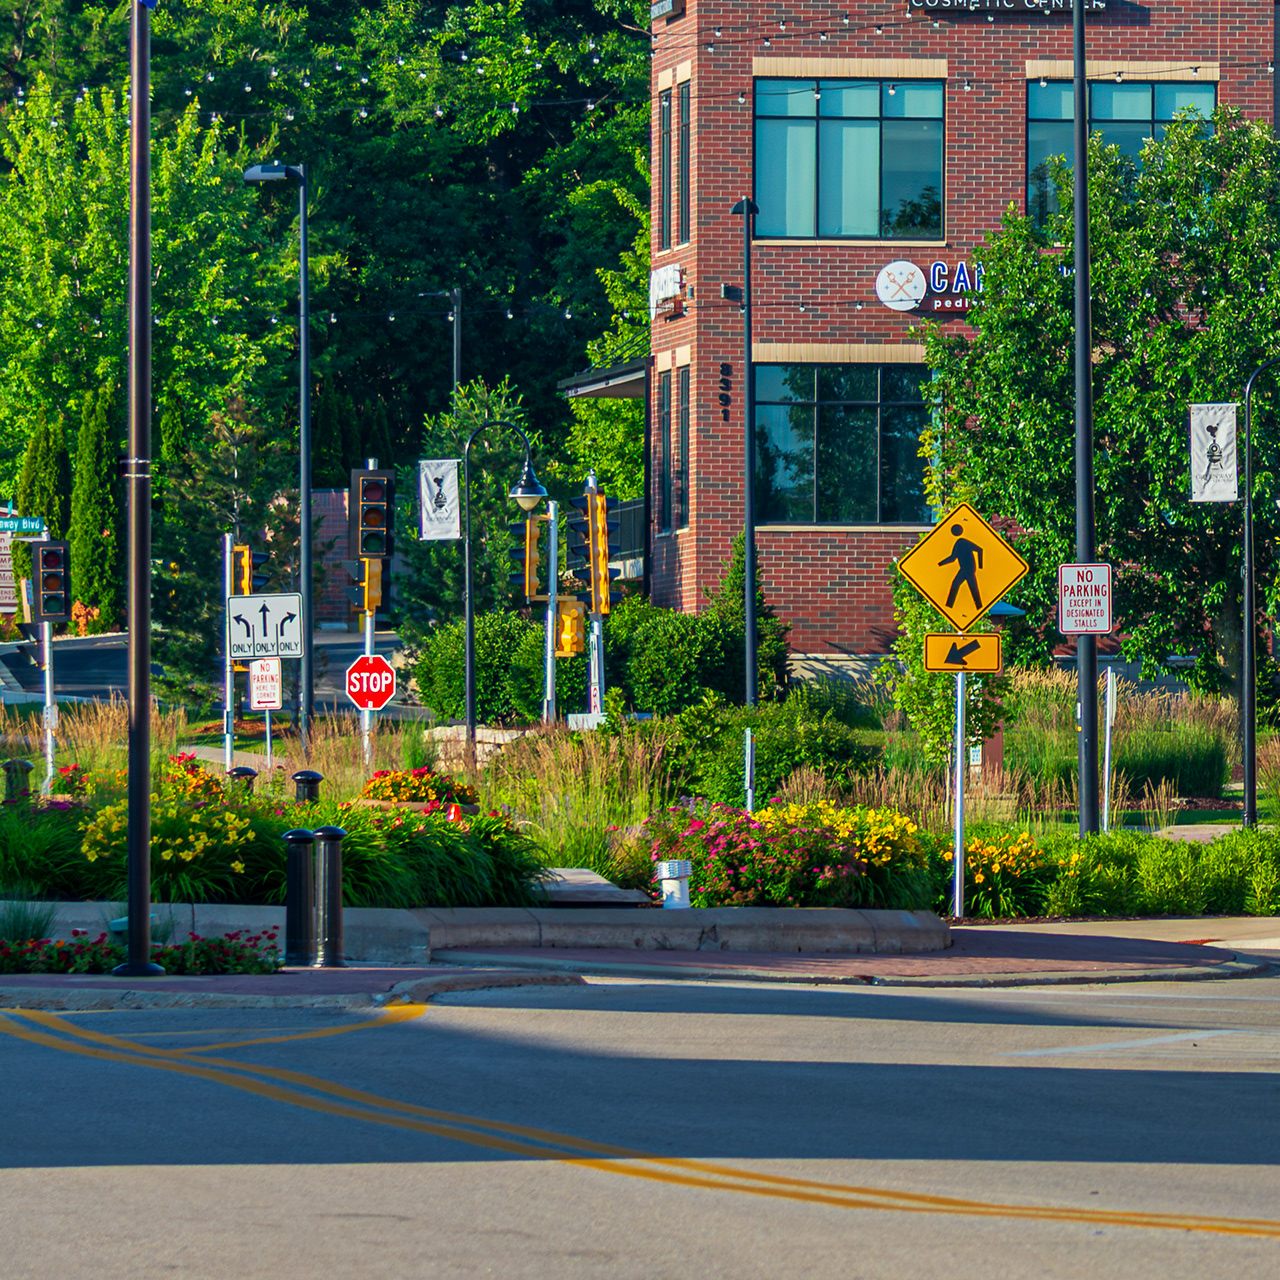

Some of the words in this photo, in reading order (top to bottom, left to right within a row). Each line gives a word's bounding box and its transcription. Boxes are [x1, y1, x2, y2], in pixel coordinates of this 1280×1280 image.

[22, 518, 40, 529] Blvd
[1077, 570, 1093, 583] NO
[1063, 584, 1107, 597] PARKING
[1070, 599, 1092, 607] EXCEPT
[1094, 599, 1102, 607] IN
[1066, 609, 1104, 618] DESIGNATED
[1074, 619, 1097, 628] STALLS
[232, 643, 252, 653] ONLY
[255, 642, 276, 653] ONLY
[280, 642, 299, 651] ONLY
[260, 663, 270, 672] NO
[253, 675, 278, 684] PARKING
[350, 671, 393, 693] STOP
